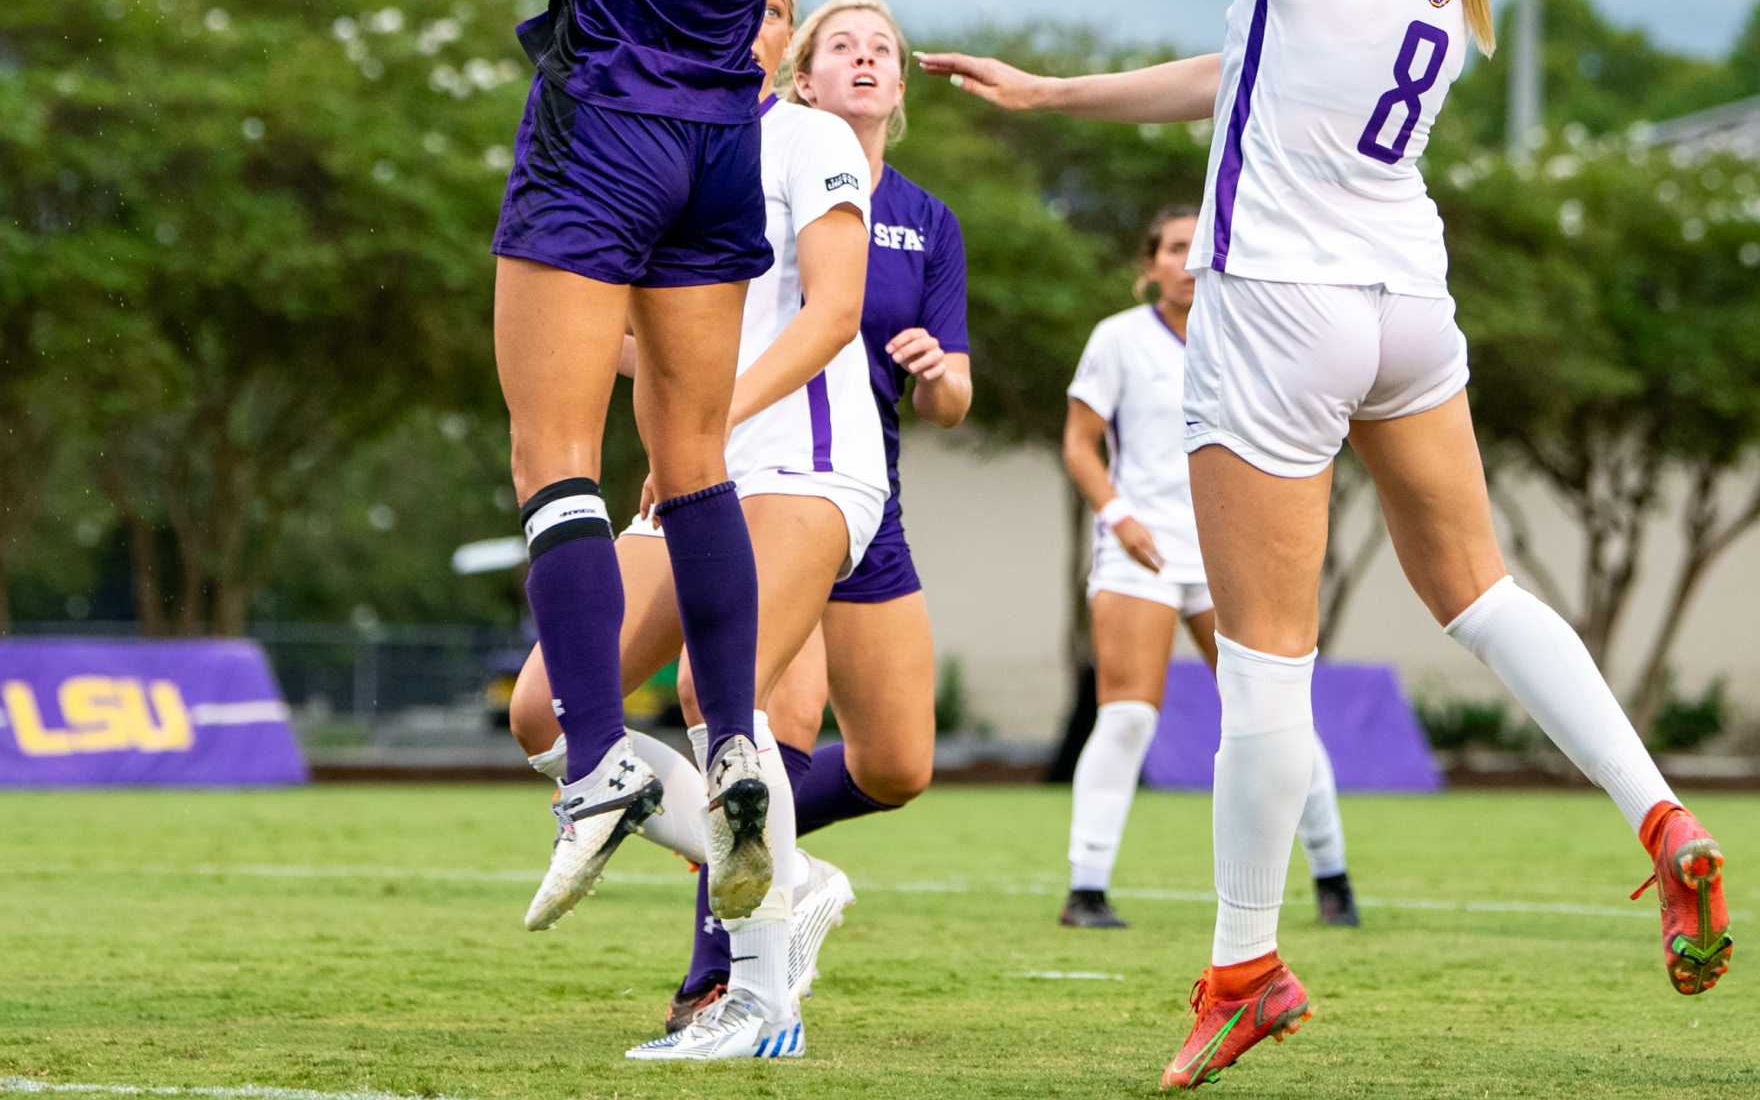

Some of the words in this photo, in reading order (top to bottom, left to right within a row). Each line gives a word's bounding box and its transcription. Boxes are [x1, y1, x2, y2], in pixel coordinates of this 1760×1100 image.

[1357, 20, 1449, 165] 8
[873, 222, 925, 252] SFA
[4, 675, 194, 756] LSU
